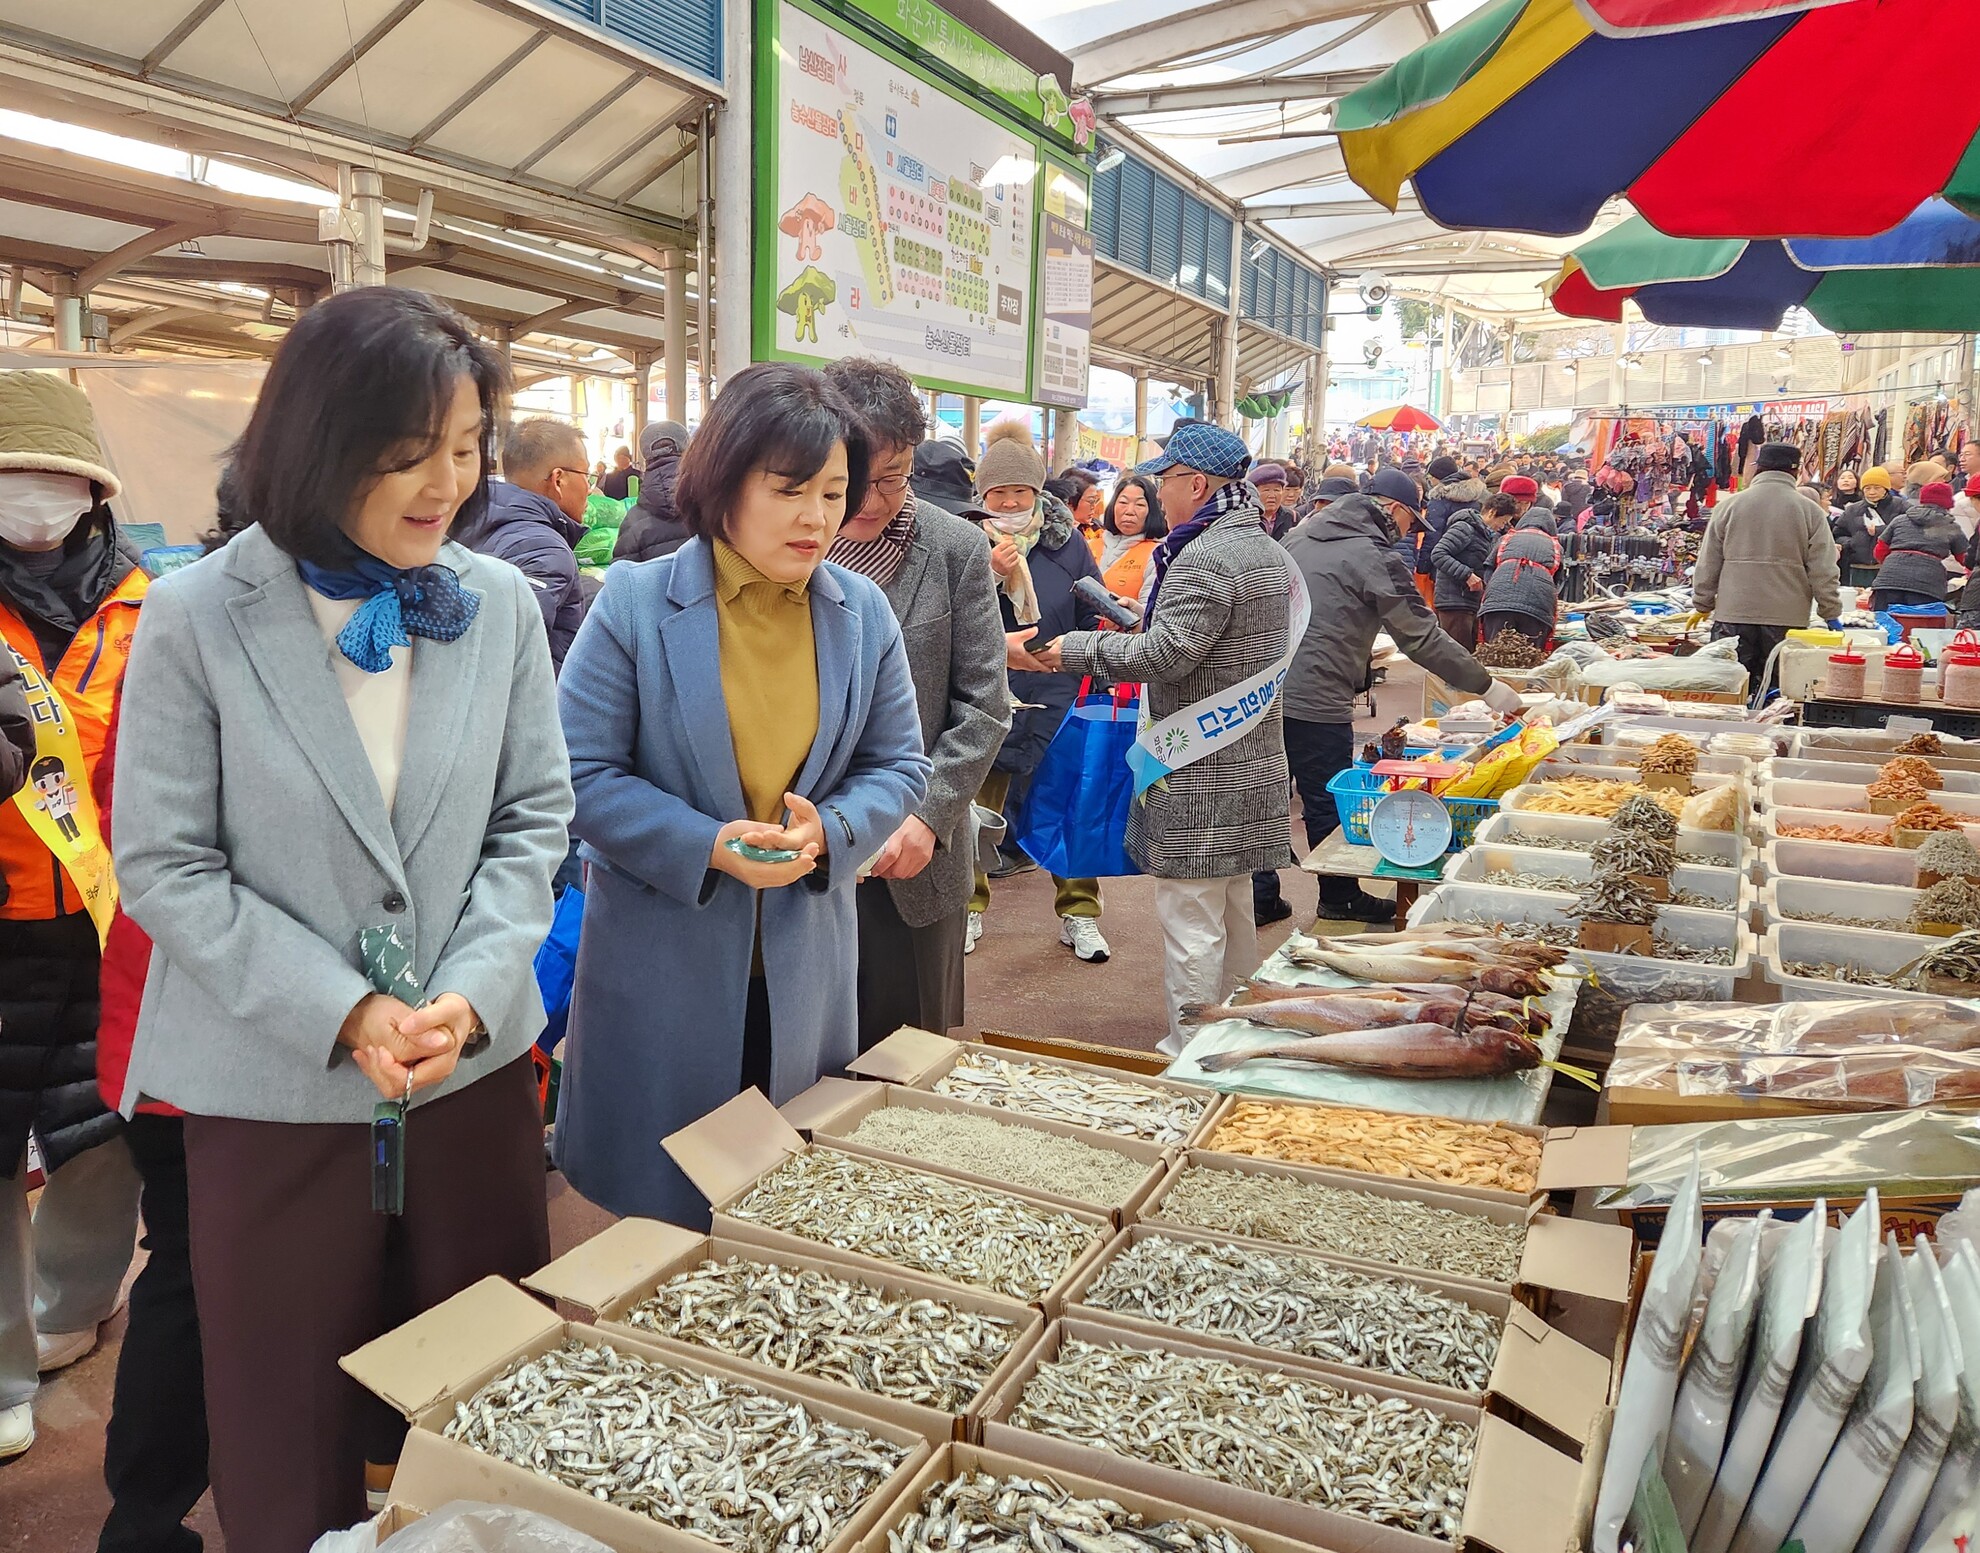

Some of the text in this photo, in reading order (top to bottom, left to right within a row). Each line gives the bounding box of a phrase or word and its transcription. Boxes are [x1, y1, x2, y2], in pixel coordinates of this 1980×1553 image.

[799, 45, 836, 86] 남산장터
[838, 54, 848, 76] 사
[791, 98, 838, 139] 농수산물장터
[855, 132, 864, 152] 다
[886, 150, 894, 168] 마
[897, 155, 924, 182] 시골장터
[849, 184, 858, 206] 바
[837, 212, 868, 240] 시골장터
[850, 287, 860, 309] 라
[1000, 295, 1020, 316] 주차장
[925, 325, 972, 358] 농수산물장터
